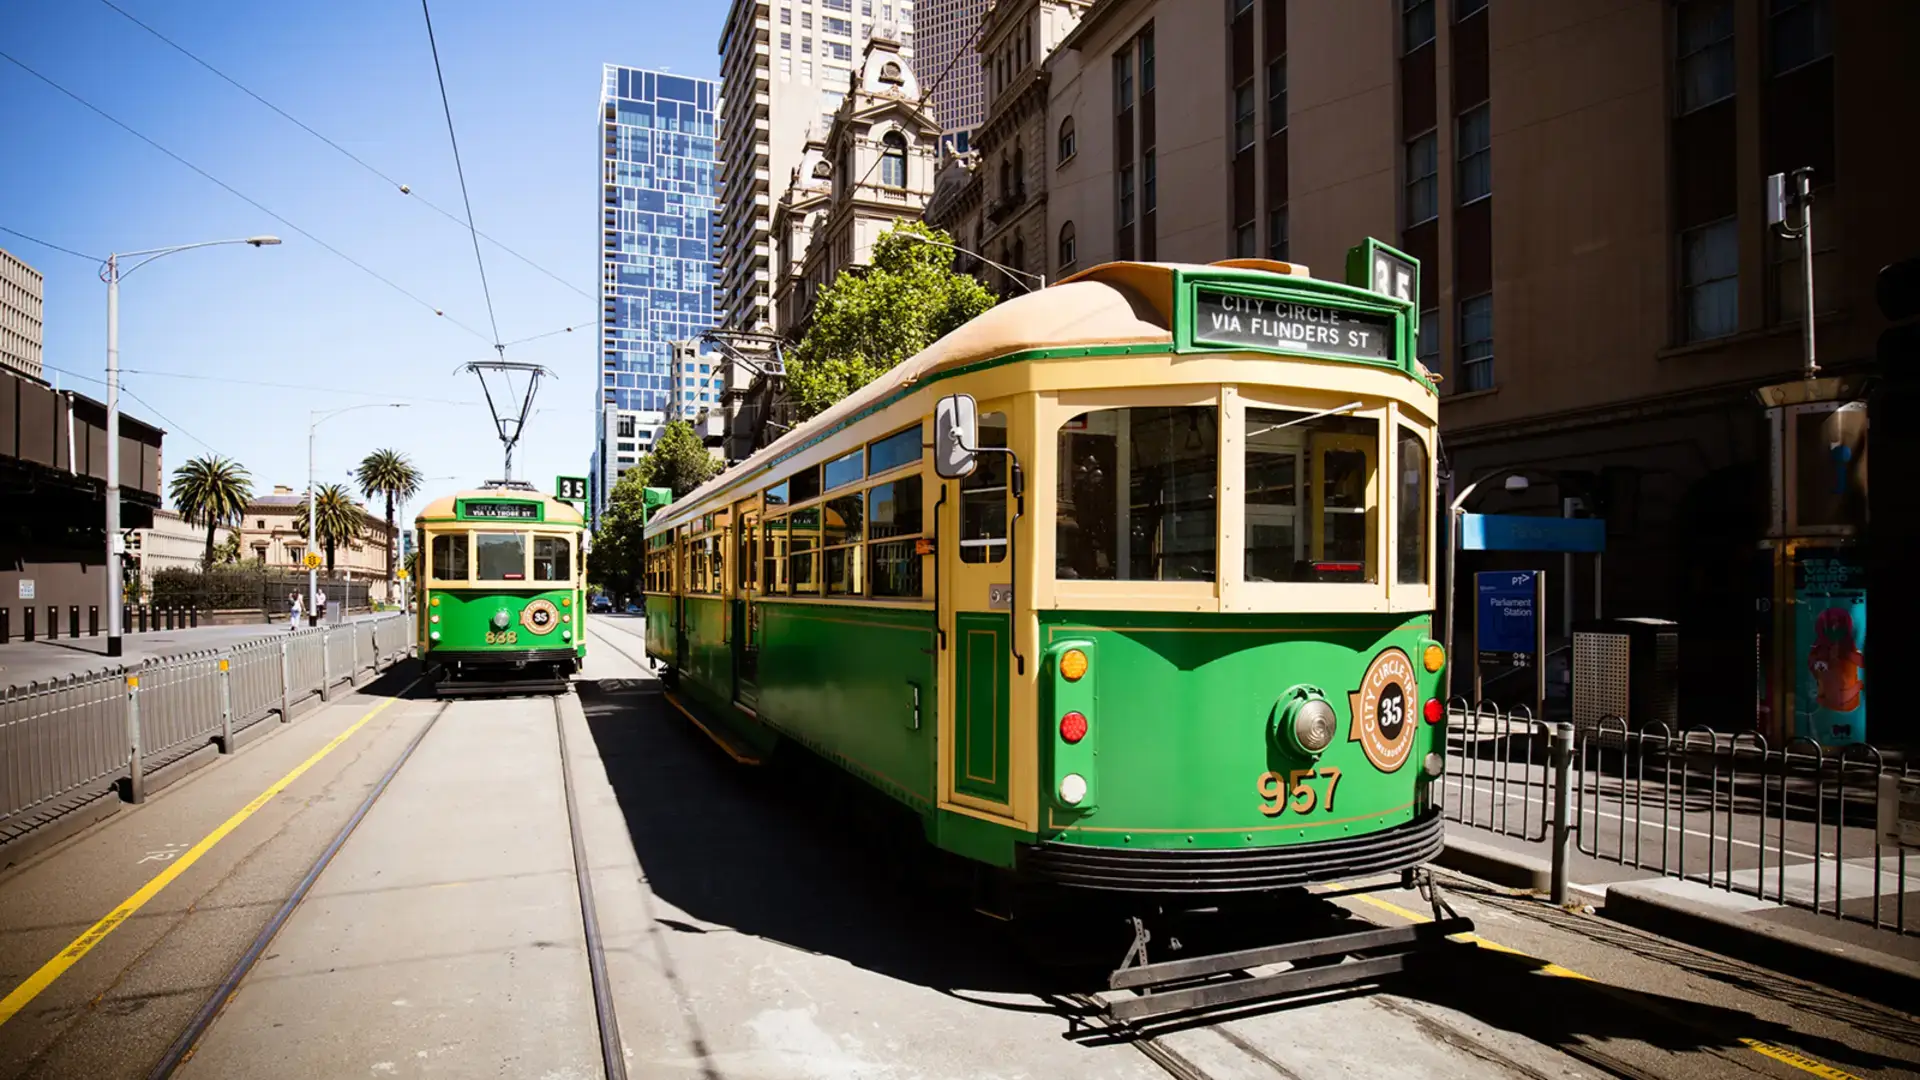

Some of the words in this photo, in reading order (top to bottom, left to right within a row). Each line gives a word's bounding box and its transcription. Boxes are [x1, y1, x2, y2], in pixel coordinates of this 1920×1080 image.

[1221, 295, 1264, 315] CITY
[1275, 303, 1340, 326] CIRCLE
[1212, 312, 1241, 333] VIA
[1251, 318, 1340, 345] FLINDERS
[1348, 330, 1369, 348] ST
[561, 480, 584, 498] 35
[534, 612, 548, 622] 35
[1490, 598, 1532, 607] Parliament
[1503, 607, 1532, 617] Station
[1364, 688, 1376, 732] CITY
[1373, 660, 1406, 687] CIRCLE
[1403, 672, 1414, 724] TRAM
[1381, 694, 1402, 727] 35
[1257, 766, 1342, 816] 957
